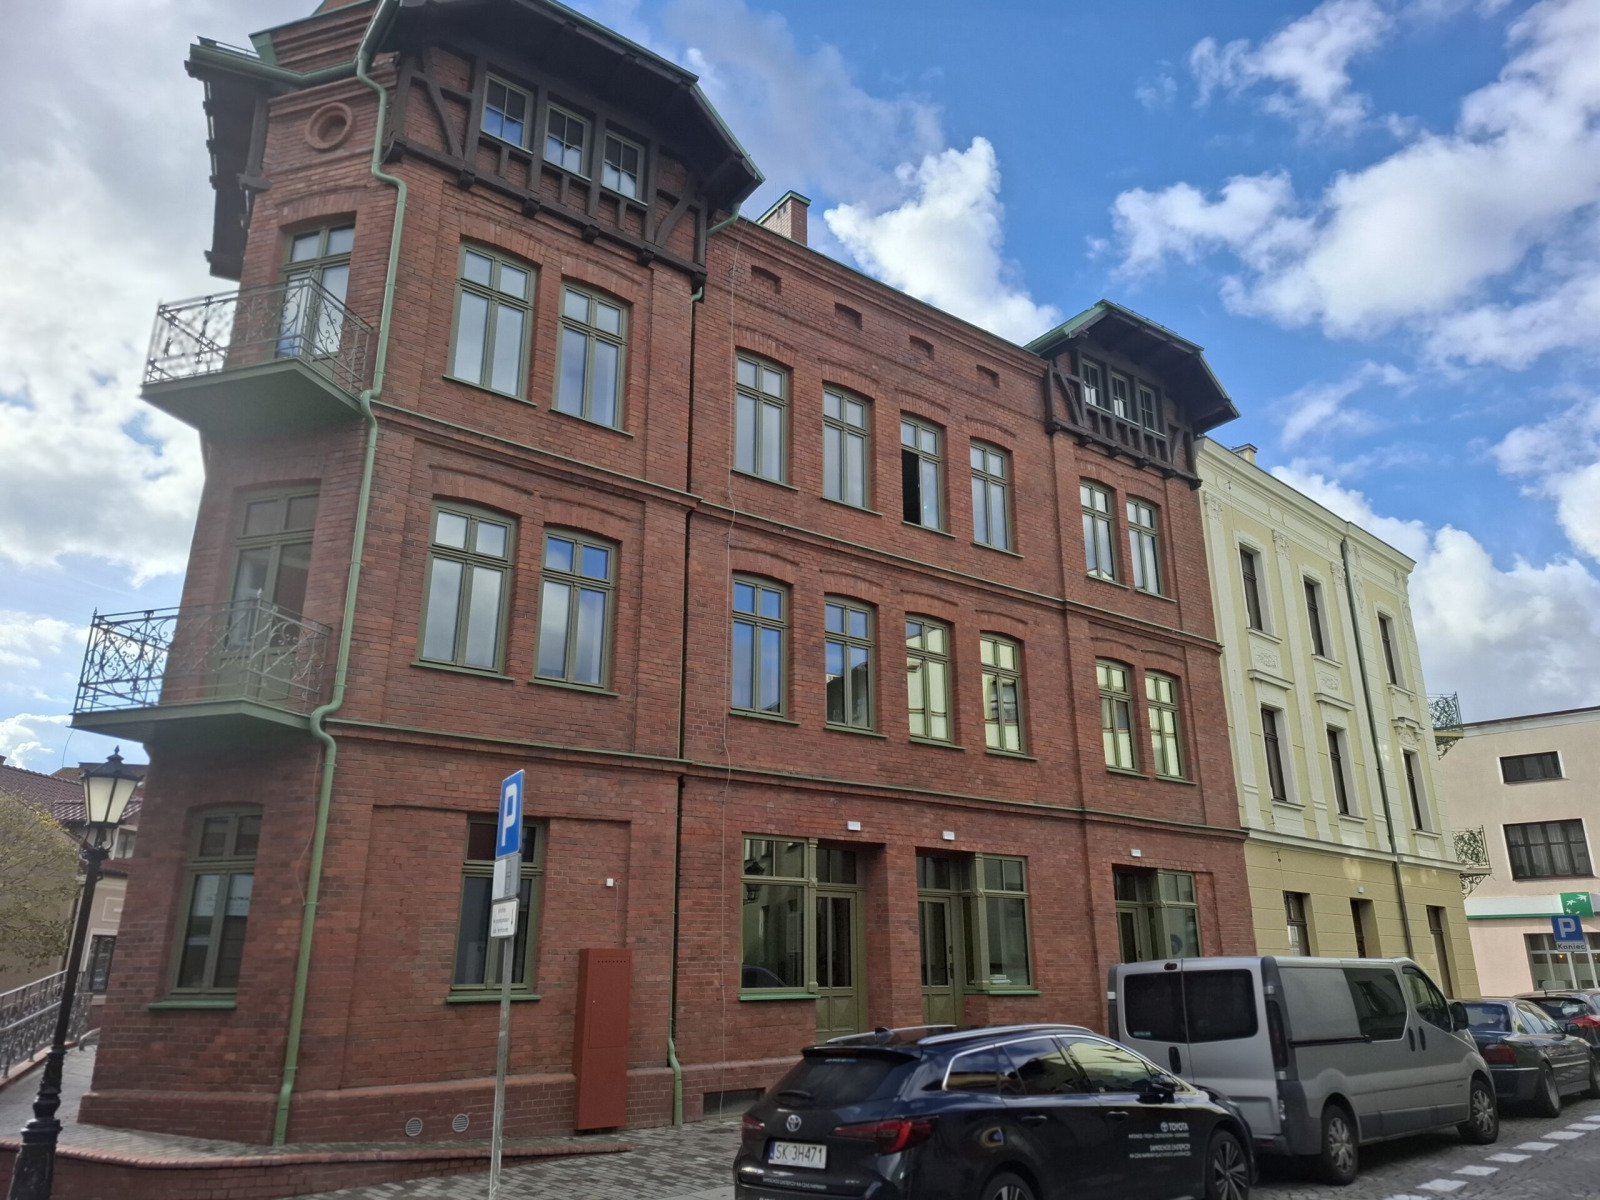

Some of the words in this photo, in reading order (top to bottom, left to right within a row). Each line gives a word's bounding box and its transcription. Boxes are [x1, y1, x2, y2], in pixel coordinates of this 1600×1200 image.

[501, 783, 518, 847] P
[1557, 917, 1576, 938] P
[1557, 943, 1586, 951] Koniec
[1168, 1122, 1189, 1131] TOYOTA
[776, 1144, 789, 1161] SK
[791, 1145, 823, 1163] 3H471
